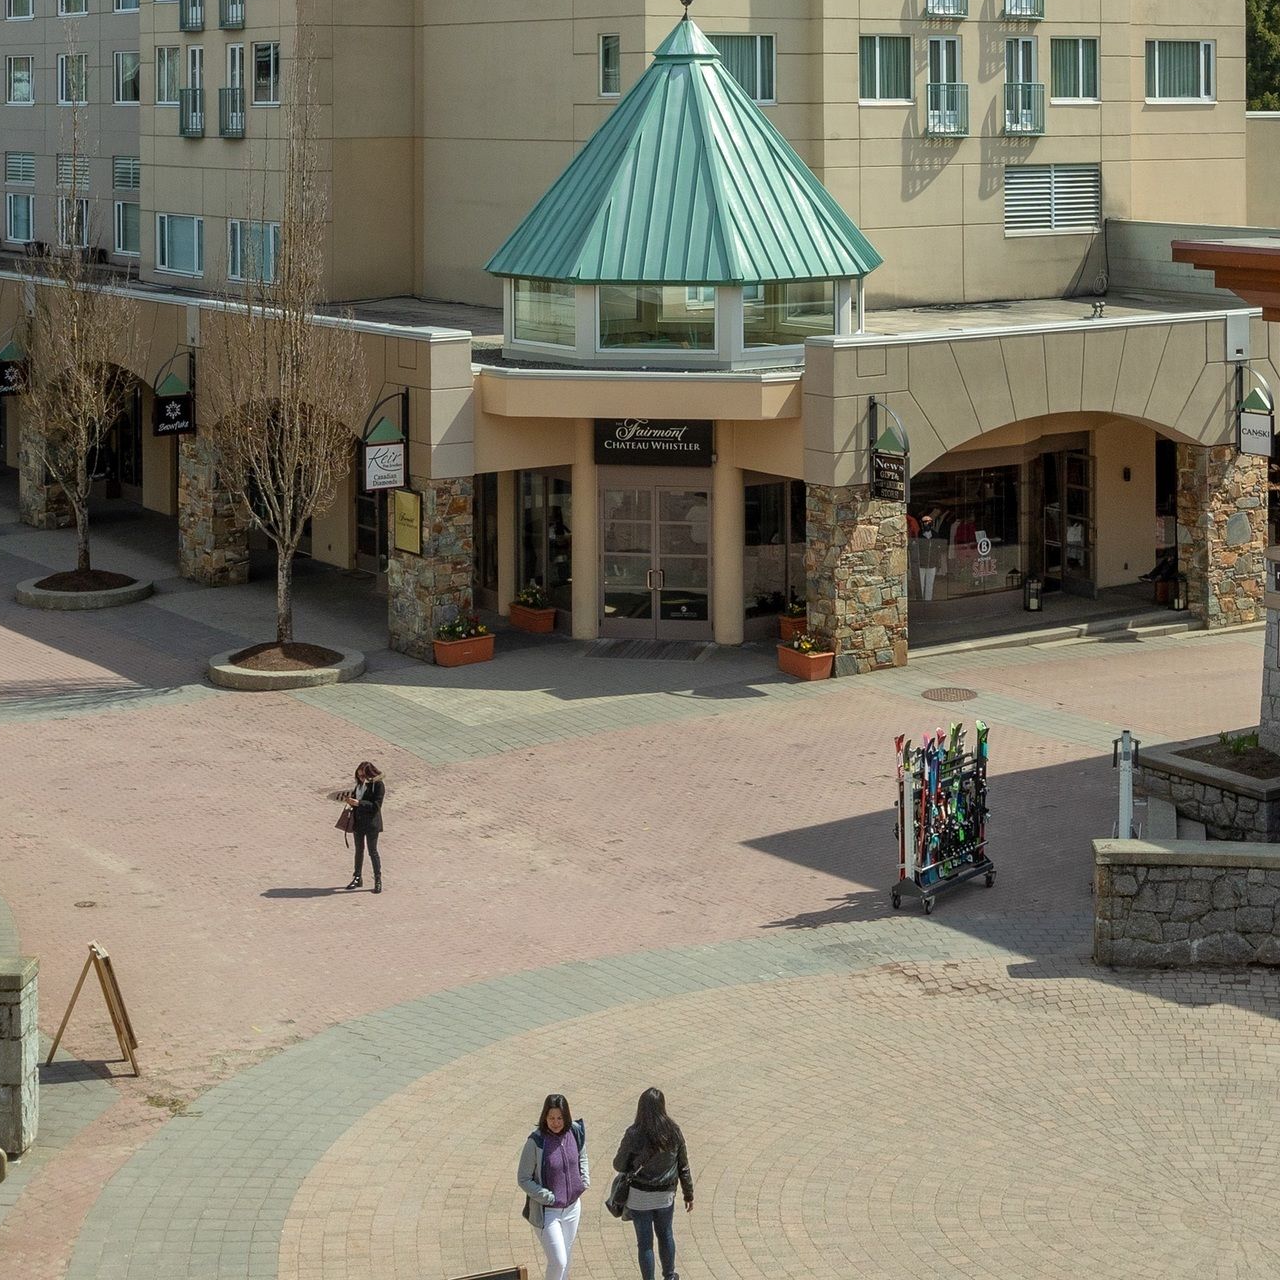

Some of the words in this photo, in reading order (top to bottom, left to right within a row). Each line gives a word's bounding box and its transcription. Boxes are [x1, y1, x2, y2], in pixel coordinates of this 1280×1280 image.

[158, 420, 190, 432] Snowflake
[615, 417, 689, 441] Fairmont
[604, 440, 649, 450] CHATEAU
[650, 441, 701, 451] WHISTLER
[368, 447, 403, 472] Keir
[373, 473, 397, 481] Canadian
[372, 479, 398, 487] Diamonds
